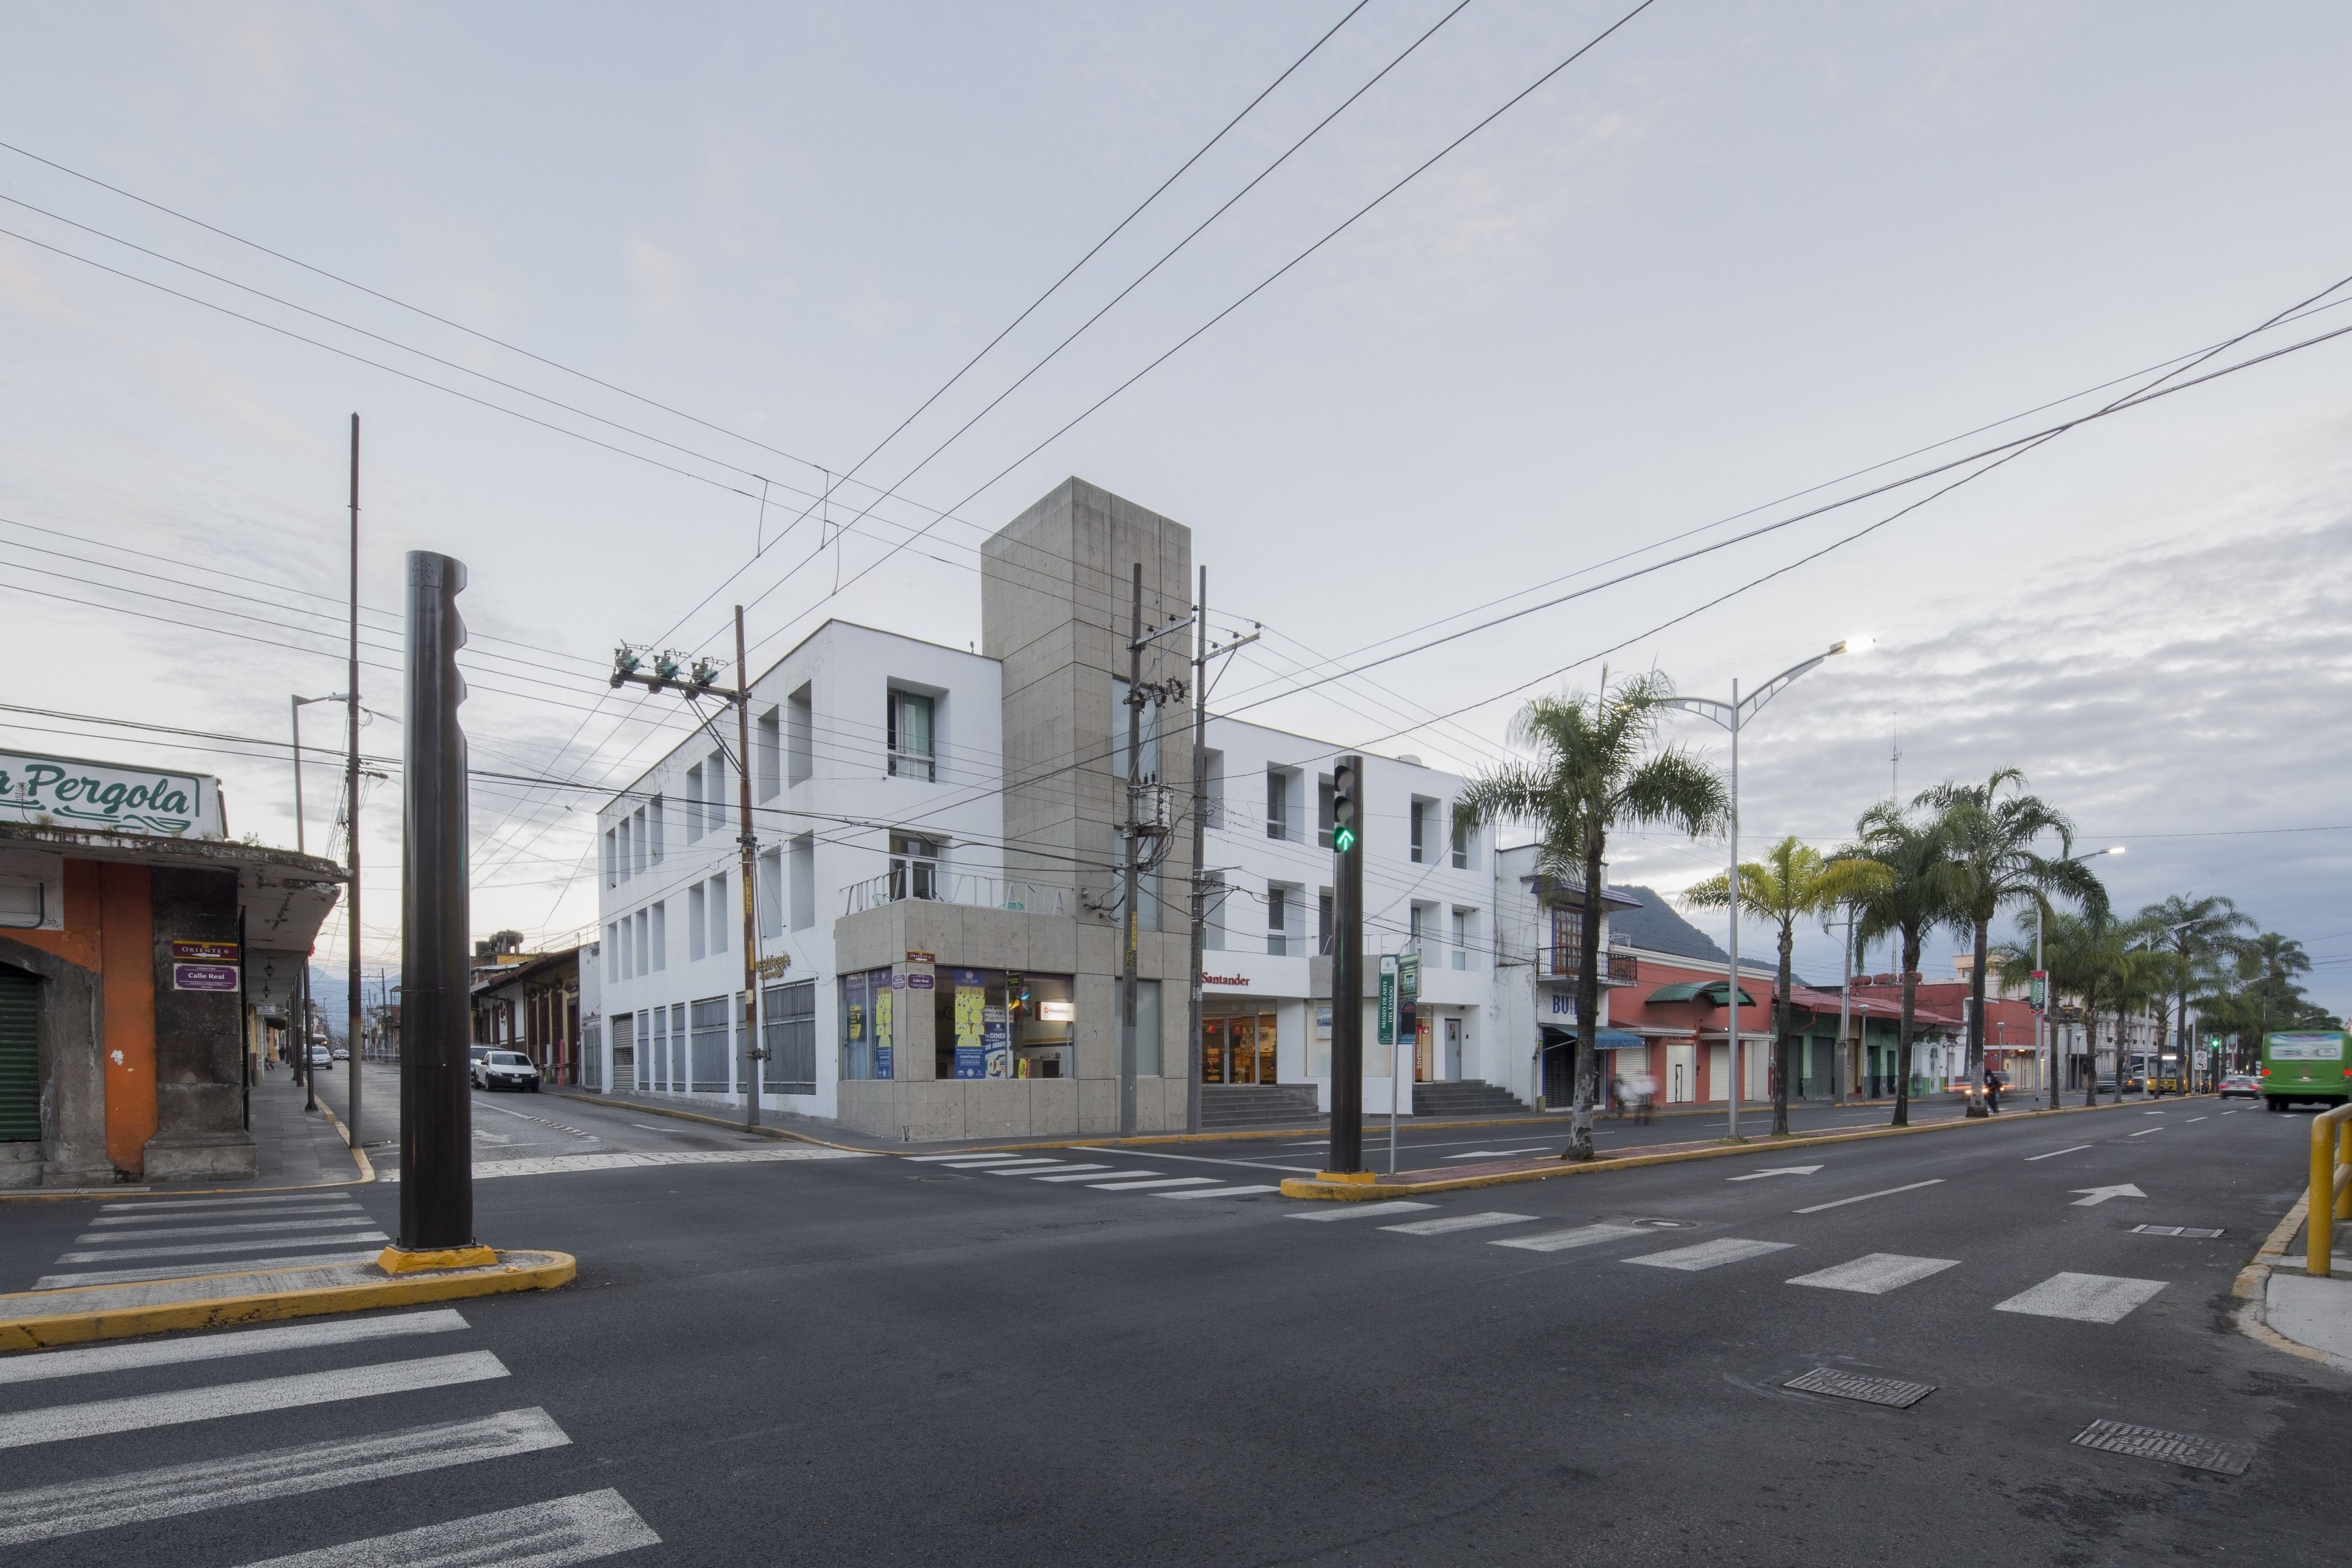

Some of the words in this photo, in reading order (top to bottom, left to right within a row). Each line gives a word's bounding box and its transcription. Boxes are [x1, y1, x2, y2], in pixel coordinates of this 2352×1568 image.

[0, 770, 15, 795] a
[24, 764, 190, 815] Pergola
[1201, 971, 1251, 986] Santander
[1382, 997, 1387, 1005] DE
